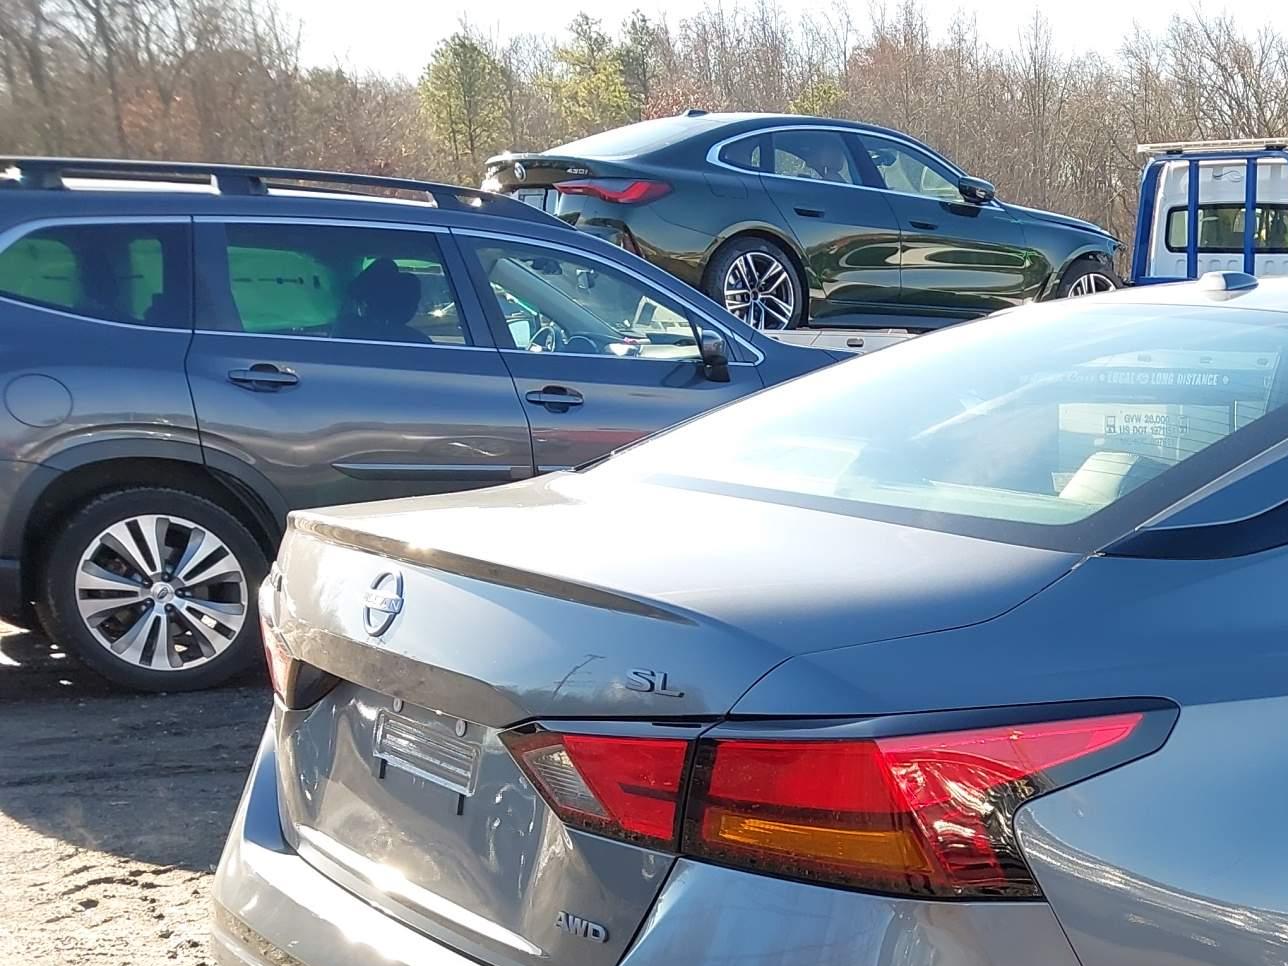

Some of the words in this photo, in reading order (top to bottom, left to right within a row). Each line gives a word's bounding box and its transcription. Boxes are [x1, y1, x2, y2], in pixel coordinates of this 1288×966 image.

[1151, 373, 1174, 384] LONG
[1177, 373, 1219, 385] DISTANCE
[1124, 414, 1142, 423] GVW
[1120, 425, 1131, 434] US
[1132, 425, 1147, 434] DOT
[626, 667, 685, 697] SL
[555, 911, 608, 942] AWD
